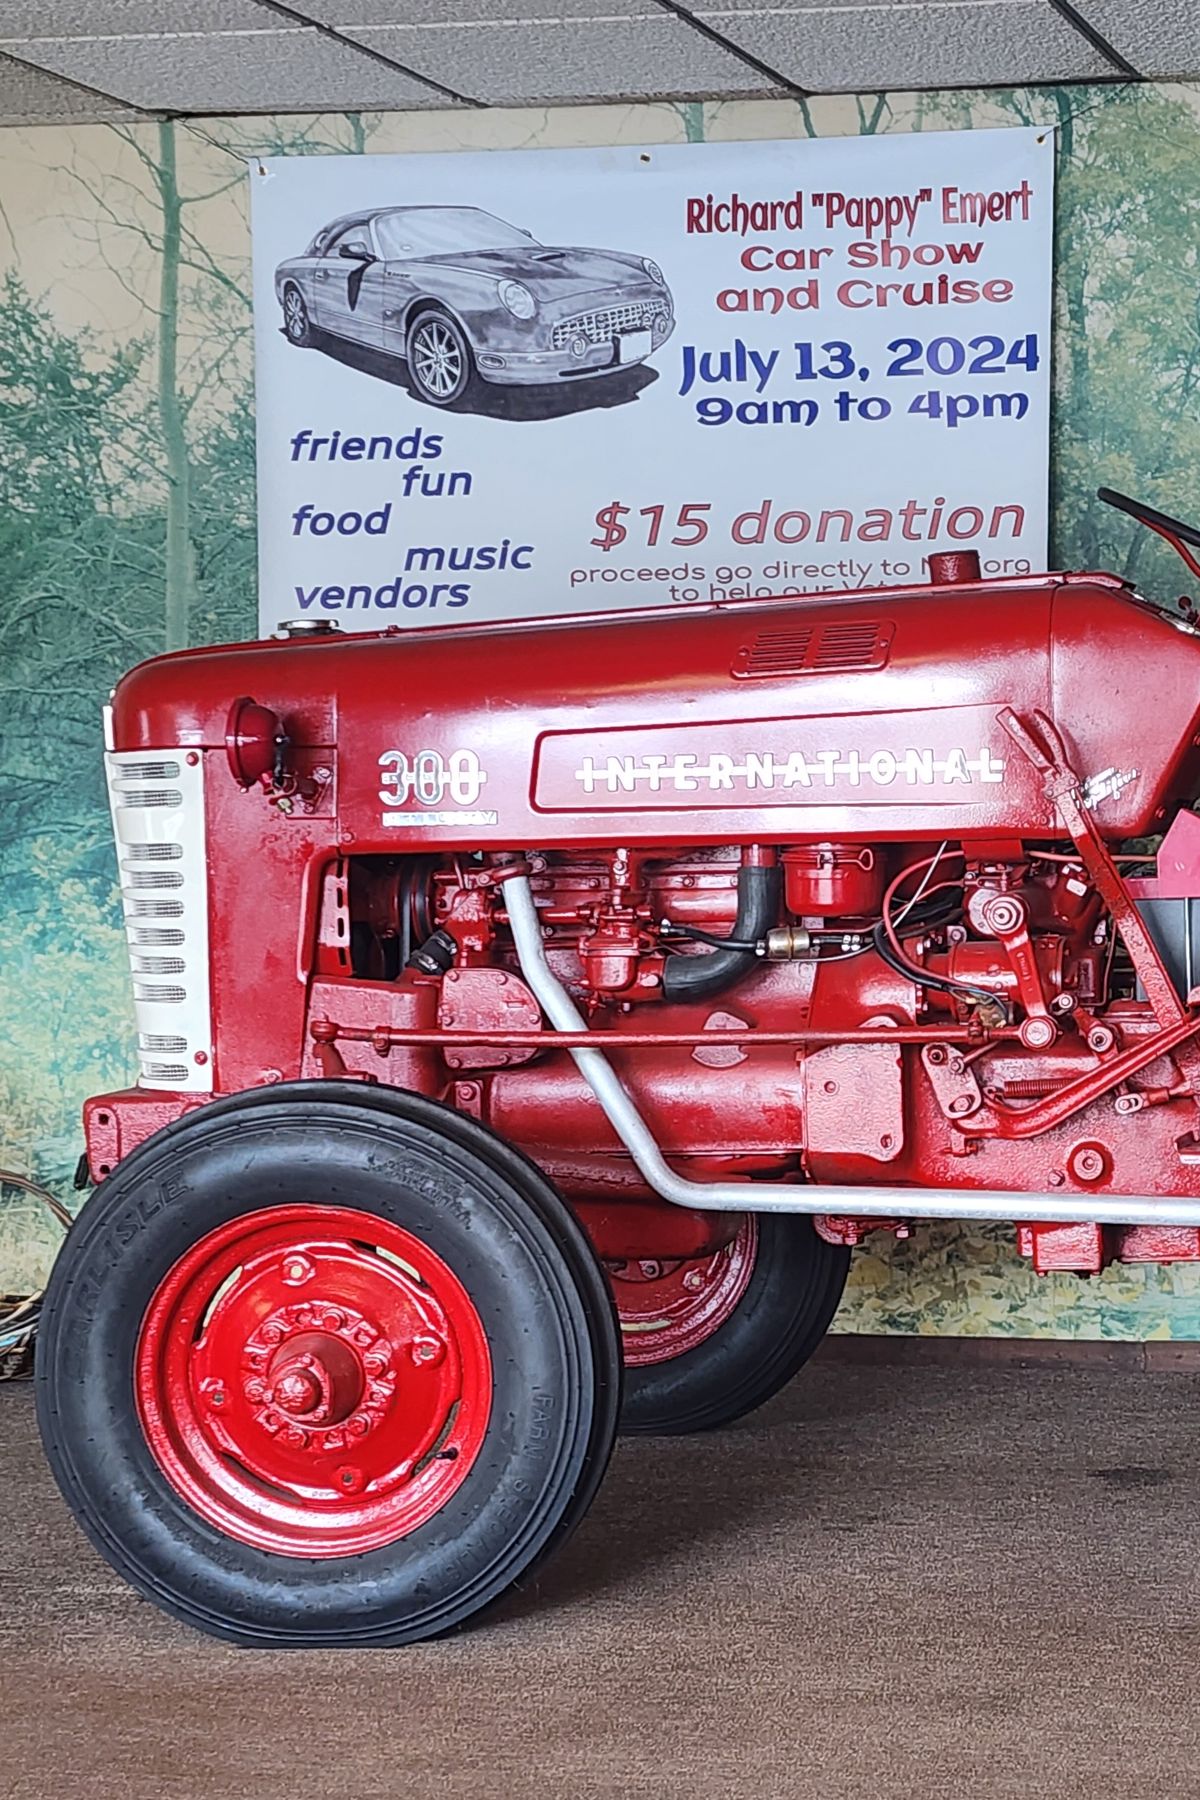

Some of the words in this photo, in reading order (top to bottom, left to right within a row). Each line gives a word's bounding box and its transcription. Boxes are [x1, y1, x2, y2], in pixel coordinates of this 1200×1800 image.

[686, 190, 803, 236] Richard
[811, 187, 932, 239] "Pappy"
[941, 180, 1033, 228] Emert
[740, 245, 834, 272] Car
[847, 238, 985, 270] Show
[716, 278, 820, 315] and
[836, 273, 1014, 309] Cruise
[678, 338, 780, 397] July
[794, 340, 870, 383] 13,
[885, 333, 1040, 377] 2024
[695, 396, 820, 427] 9am
[833, 390, 892, 422] to
[907, 390, 1030, 428] 4pm
[290, 427, 444, 462] friends
[402, 465, 473, 497] fun
[292, 503, 393, 536] food
[590, 500, 712, 552] $15
[730, 496, 1027, 545] donation
[404, 539, 535, 572] music
[570, 563, 706, 588] proceeds
[715, 566, 753, 584] go
[762, 559, 873, 583] directly
[880, 558, 911, 577] to
[294, 576, 472, 610] vendors
[669, 585, 700, 601] to
[378, 748, 488, 807] 300
[575, 747, 1006, 792] INTERNATIONAL
